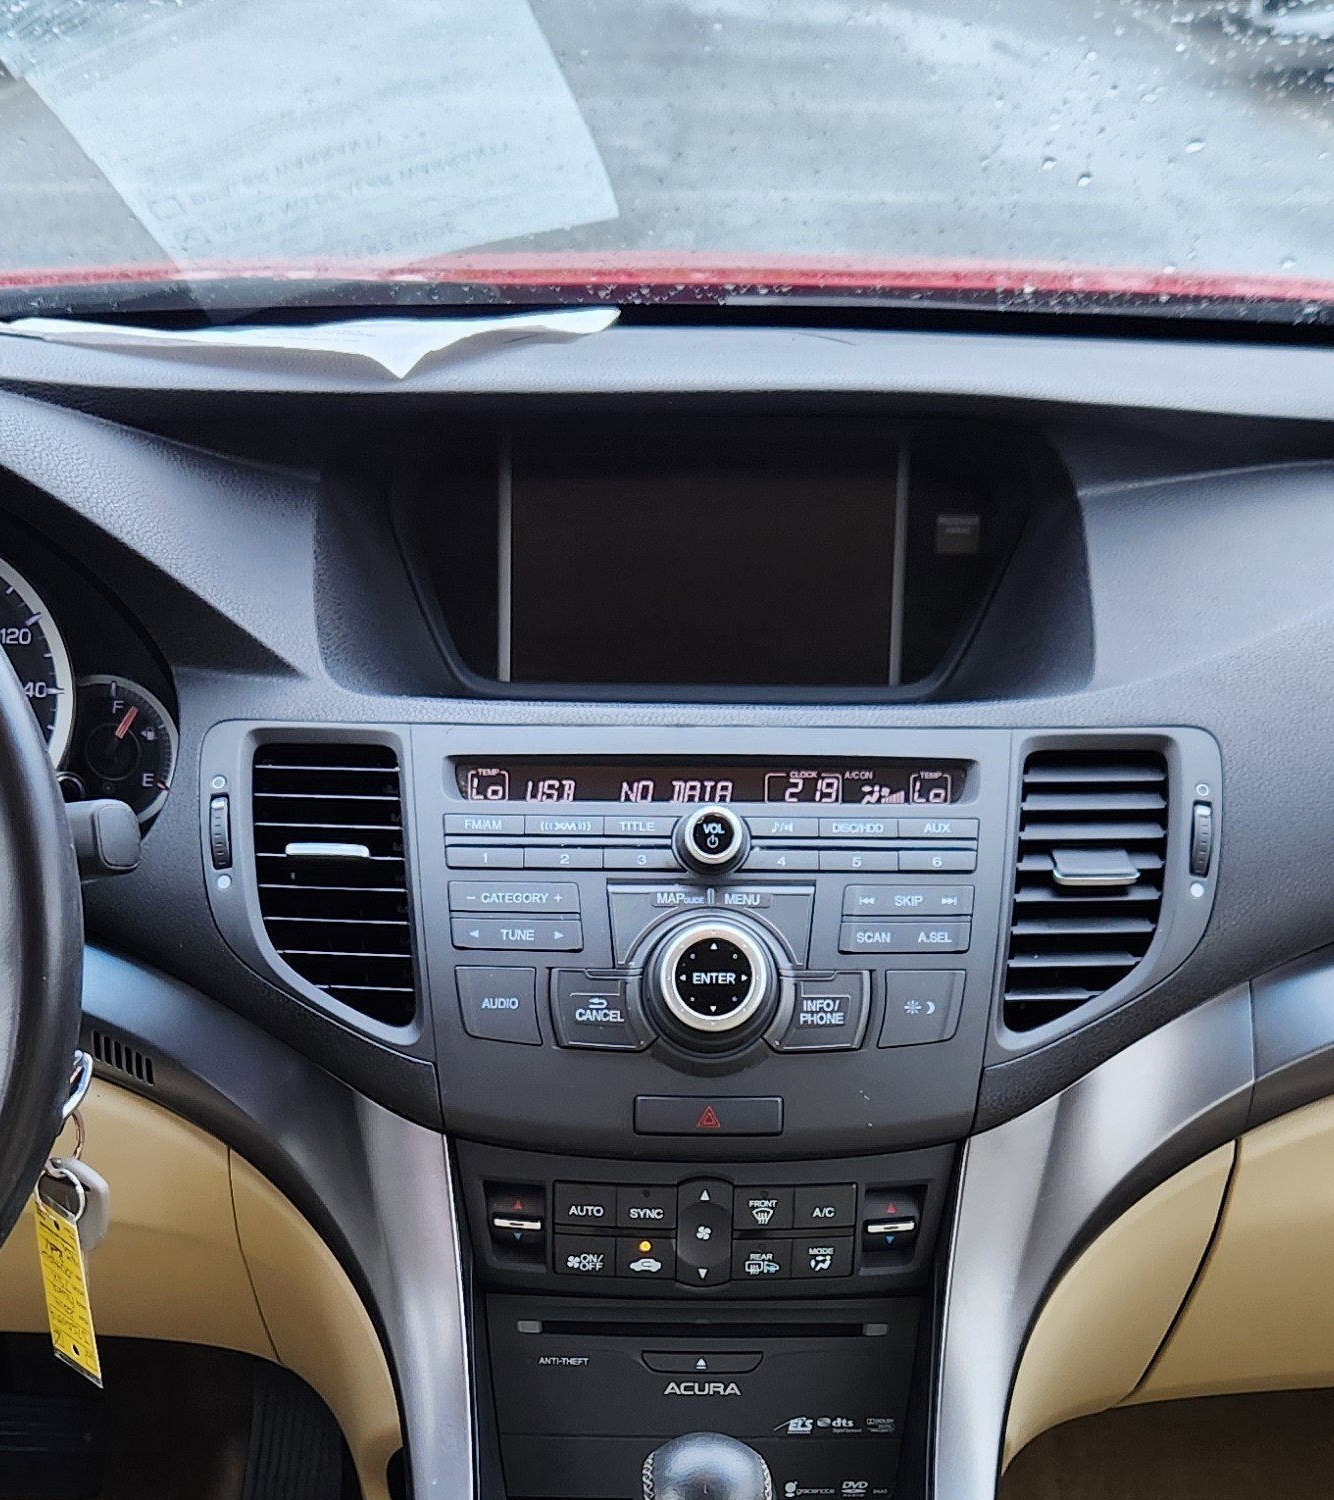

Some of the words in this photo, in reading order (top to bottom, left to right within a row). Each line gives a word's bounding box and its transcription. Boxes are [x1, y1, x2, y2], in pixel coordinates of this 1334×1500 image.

[0, 628, 32, 645] 120
[24, 682, 47, 698] 40
[112, 700, 124, 714] F
[478, 768, 500, 776] TEMP
[790, 771, 817, 779] CLOCK
[142, 773, 154, 787] E
[526, 779, 576, 802] USB
[620, 780, 654, 802] NO
[670, 780, 732, 803] DATA
[464, 820, 502, 831] FM/AM
[619, 821, 655, 832] TITLE
[703, 823, 725, 834] VOL
[832, 823, 883, 833] DISC/HDD
[924, 823, 951, 833] AUX
[482, 854, 488, 864] 1
[560, 855, 570, 865] 2
[637, 855, 647, 865] 3
[777, 857, 787, 867] 4
[852, 857, 862, 868] 5
[932, 857, 942, 868] 6
[481, 893, 548, 903] CATEGORY
[656, 893, 683, 904] MAP
[725, 894, 760, 905] MENU
[895, 895, 923, 906] SKIP
[501, 929, 534, 940] TUNE
[856, 932, 890, 943] SCAN
[918, 932, 952, 943] A.SEL
[692, 973, 736, 985] ENTER
[481, 998, 519, 1009] AUDIO
[803, 1000, 840, 1011] INFO/
[575, 1010, 624, 1022] CANCEL
[800, 1013, 844, 1024] PHONE
[749, 1200, 778, 1208] FRONT
[569, 1205, 604, 1217] AUTO
[629, 1208, 664, 1219] SYNC
[812, 1207, 836, 1218] A/C
[809, 1247, 835, 1255] MODE
[580, 1253, 604, 1262] ON/
[580, 1262, 604, 1271] OFF
[538, 1357, 589, 1367] ANTI-THEFT
[664, 1381, 742, 1396] ACURA
[832, 1417, 854, 1427] dts
[842, 1481, 869, 1489] DVD
